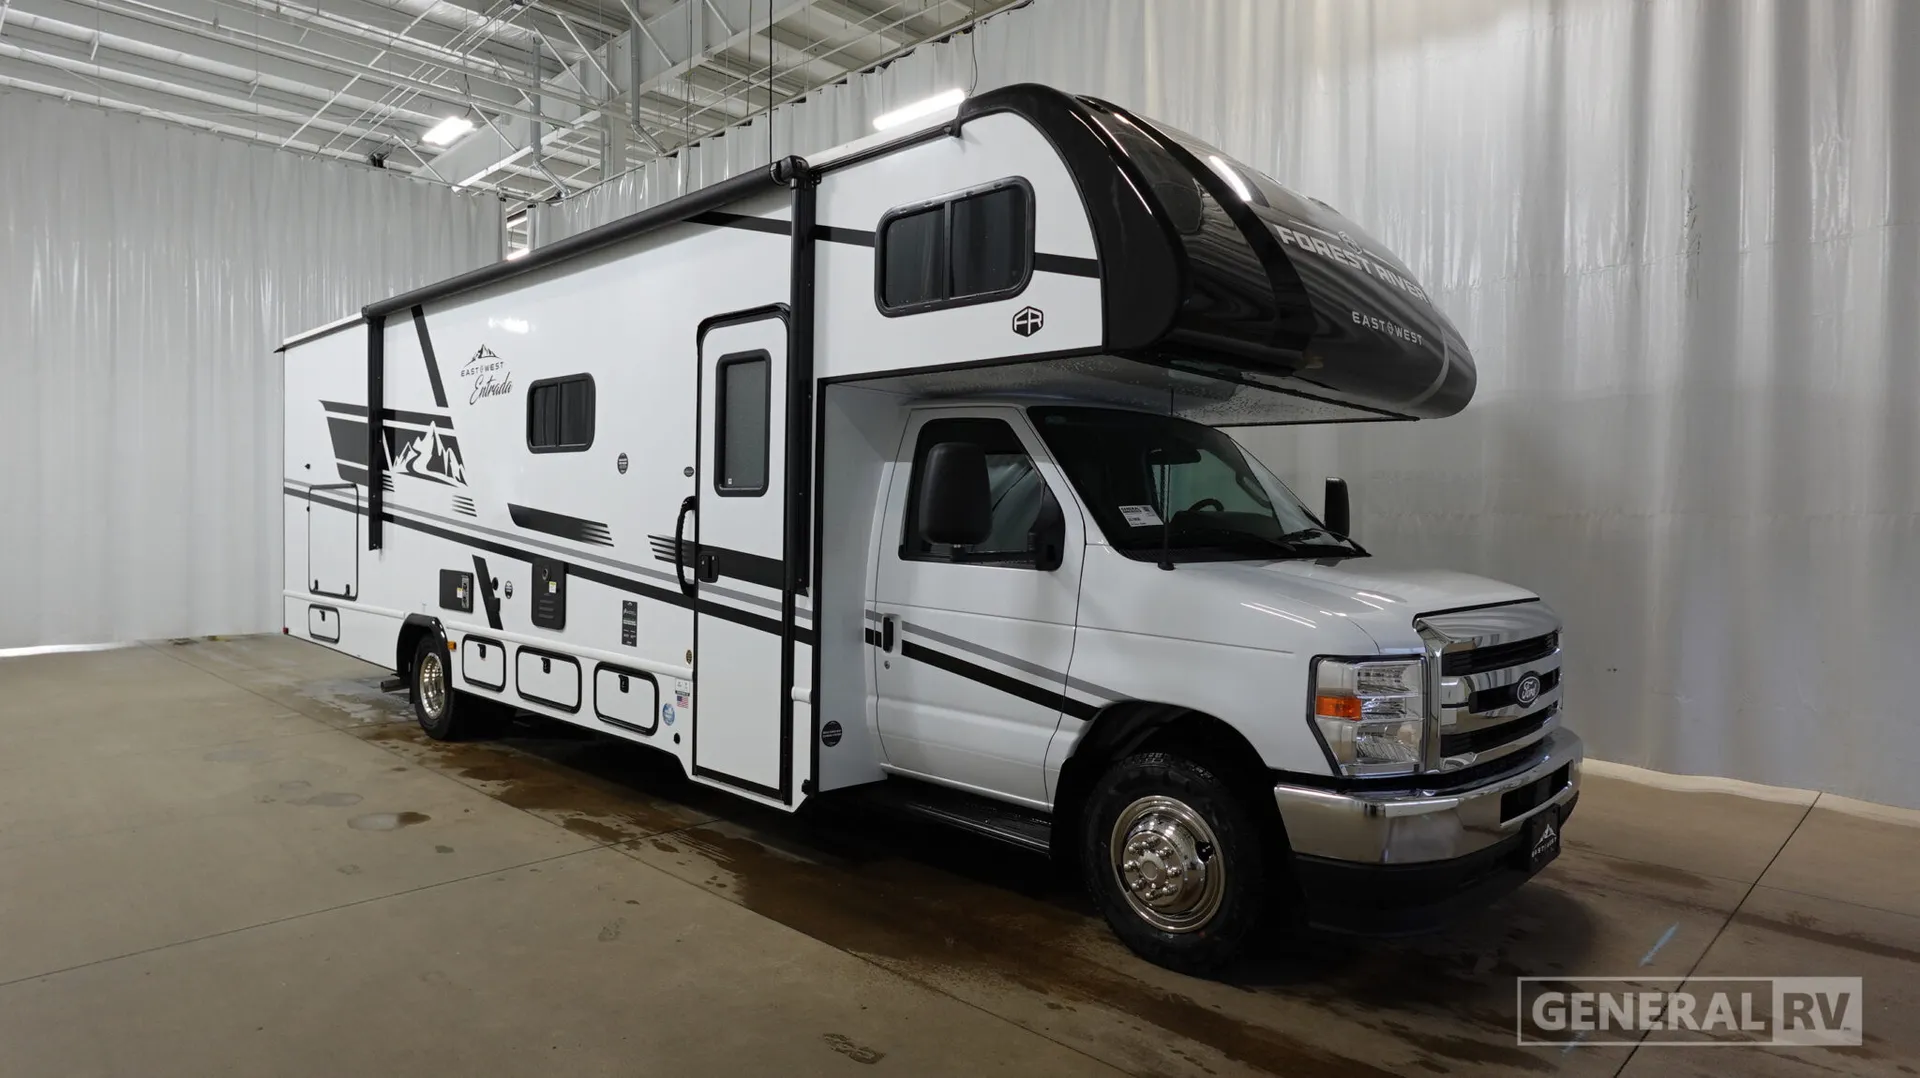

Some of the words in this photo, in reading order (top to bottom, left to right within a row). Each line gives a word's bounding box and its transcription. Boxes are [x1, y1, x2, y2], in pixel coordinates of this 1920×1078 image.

[1273, 225, 1375, 275] FOREST
[1374, 263, 1429, 303] RIVER
[1352, 311, 1385, 332] EAST
[1394, 325, 1423, 345] WEST
[469, 371, 512, 405] Entrada
